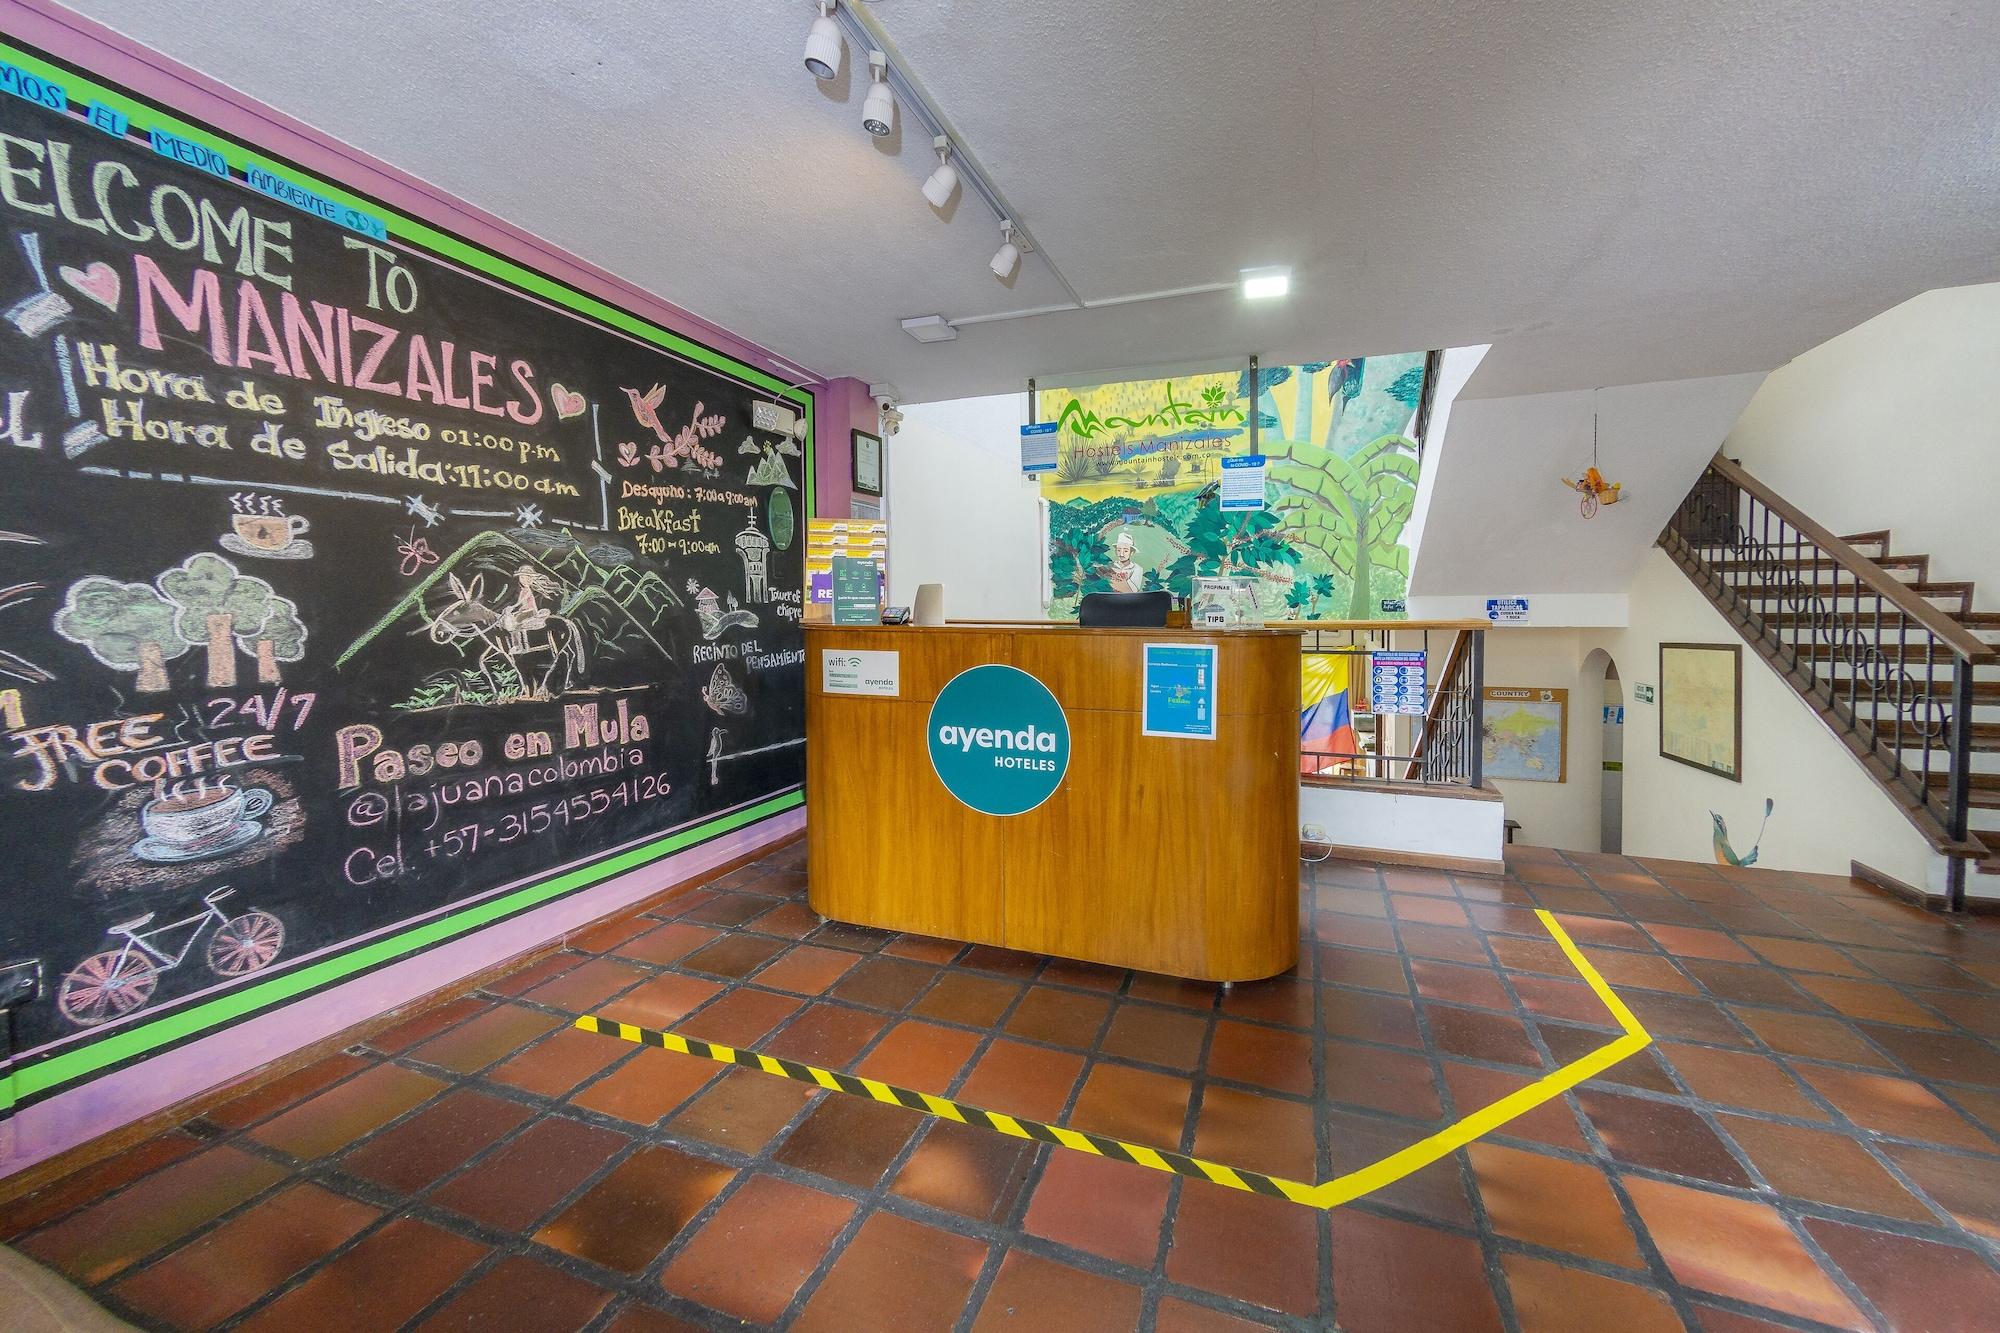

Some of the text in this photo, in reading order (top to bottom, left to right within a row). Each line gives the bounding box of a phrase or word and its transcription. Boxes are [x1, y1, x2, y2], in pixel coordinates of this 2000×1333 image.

[95, 106, 125, 137] EL
[155, 133, 227, 177] MEDIO
[251, 168, 336, 218] AMBIENTE
[343, 235, 418, 313] TO
[134, 253, 543, 426] MANIZALES
[77, 341, 214, 403] Hora
[226, 380, 287, 415] de
[313, 395, 431, 442] Ingreso
[440, 428, 513, 453] 01:00
[101, 398, 234, 450] Hora
[251, 421, 307, 459] de
[1074, 442, 1133, 460] Hostels
[1140, 436, 1231, 453] Manizales
[1096, 453, 1211, 466] www.mountainhostels.com.co
[741, 640, 762, 655] DEL
[828, 656, 847, 667] wifi:
[207, 686, 317, 731] 24/7
[864, 678, 894, 687] ayenda
[1490, 690, 1530, 698] COUNTRY
[10, 712, 165, 791] FREE
[93, 734, 282, 790] COFFEE
[335, 698, 650, 790] Paseo en Mula
[939, 724, 1056, 753] ayenda
[994, 756, 1056, 772] HOTELES
[347, 748, 643, 831] @lajuanacolombia
[423, 772, 672, 859] +57-3154554126
